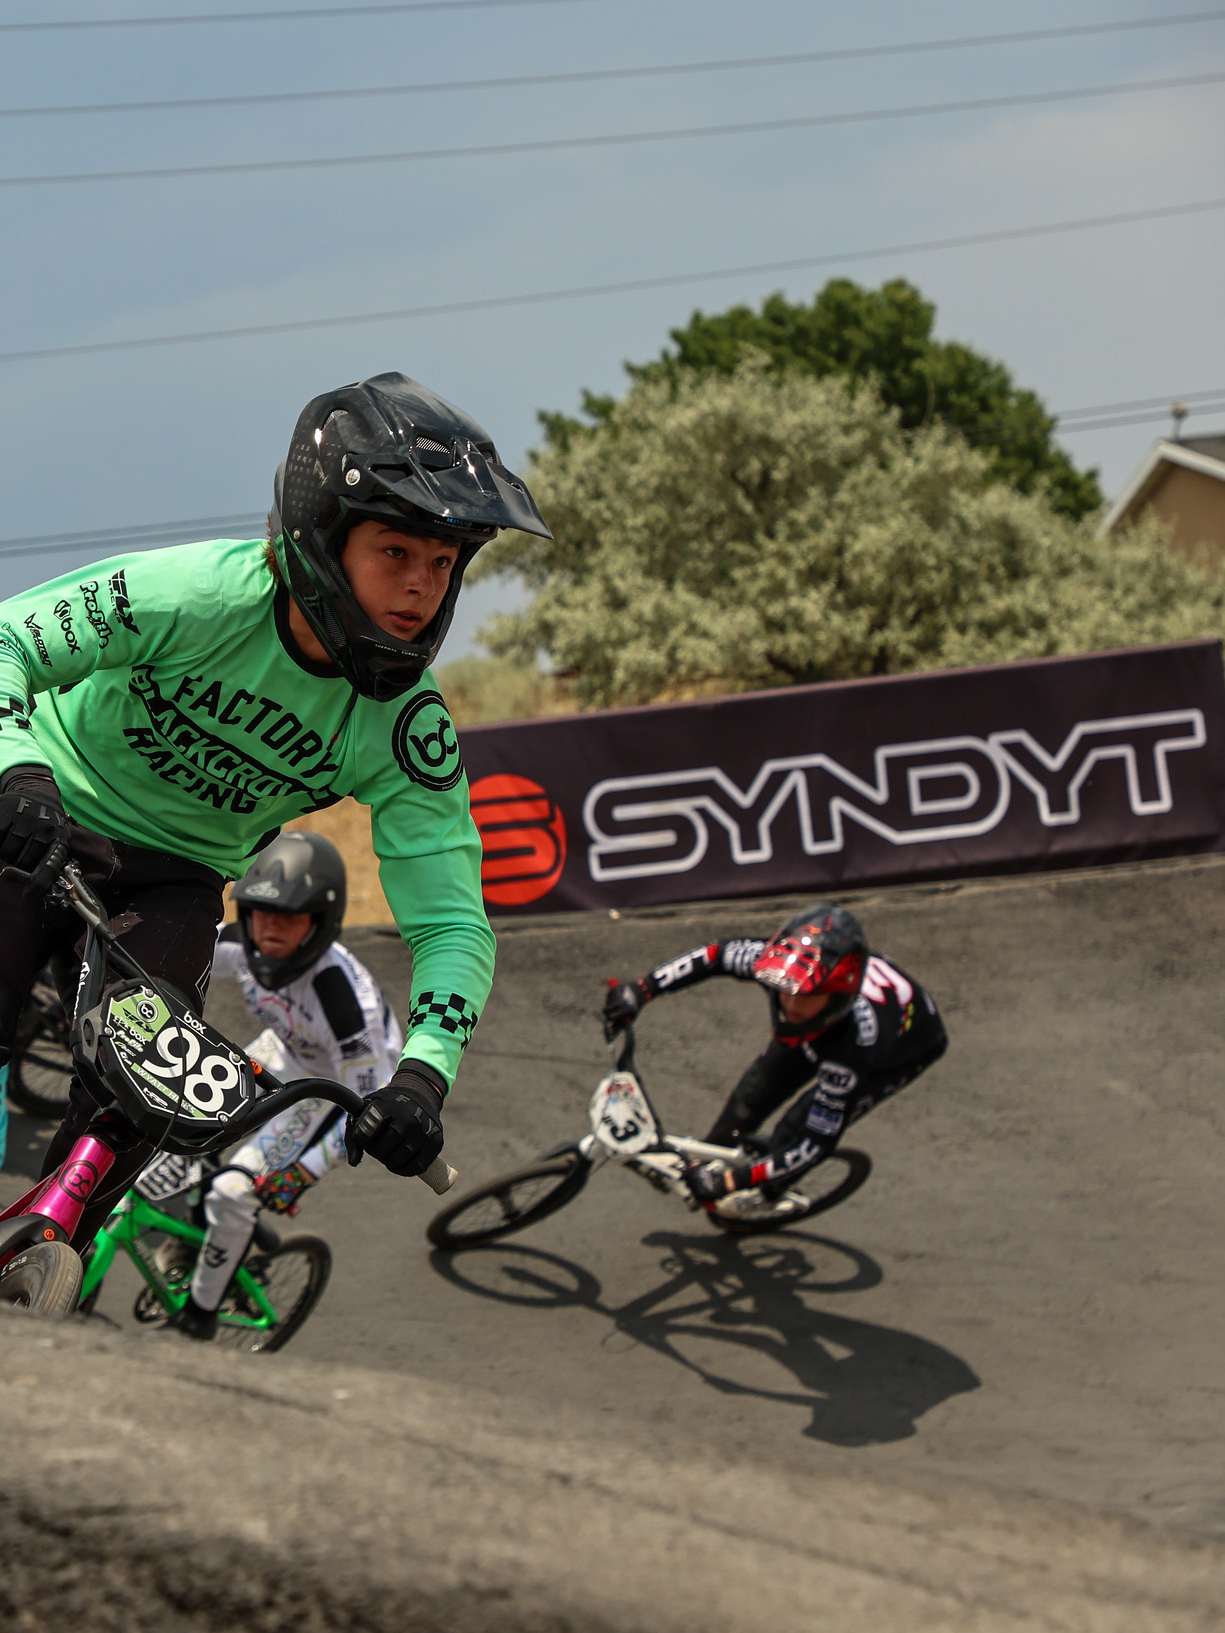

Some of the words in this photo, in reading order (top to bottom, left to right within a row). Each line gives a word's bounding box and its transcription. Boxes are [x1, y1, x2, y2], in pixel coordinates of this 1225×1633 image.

[108, 580, 122, 624] RACING
[112, 569, 141, 635] FLY
[60, 617, 83, 655] box
[172, 675, 339, 779] FACTORY
[123, 727, 257, 814] RACING
[16, 796, 69, 828] FLY
[582, 708, 1206, 883] SYNDYT
[129, 1026, 149, 1045] box
[183, 1010, 207, 1035] box
[136, 1066, 168, 1094] WYATT
[141, 1026, 239, 1112] 98
